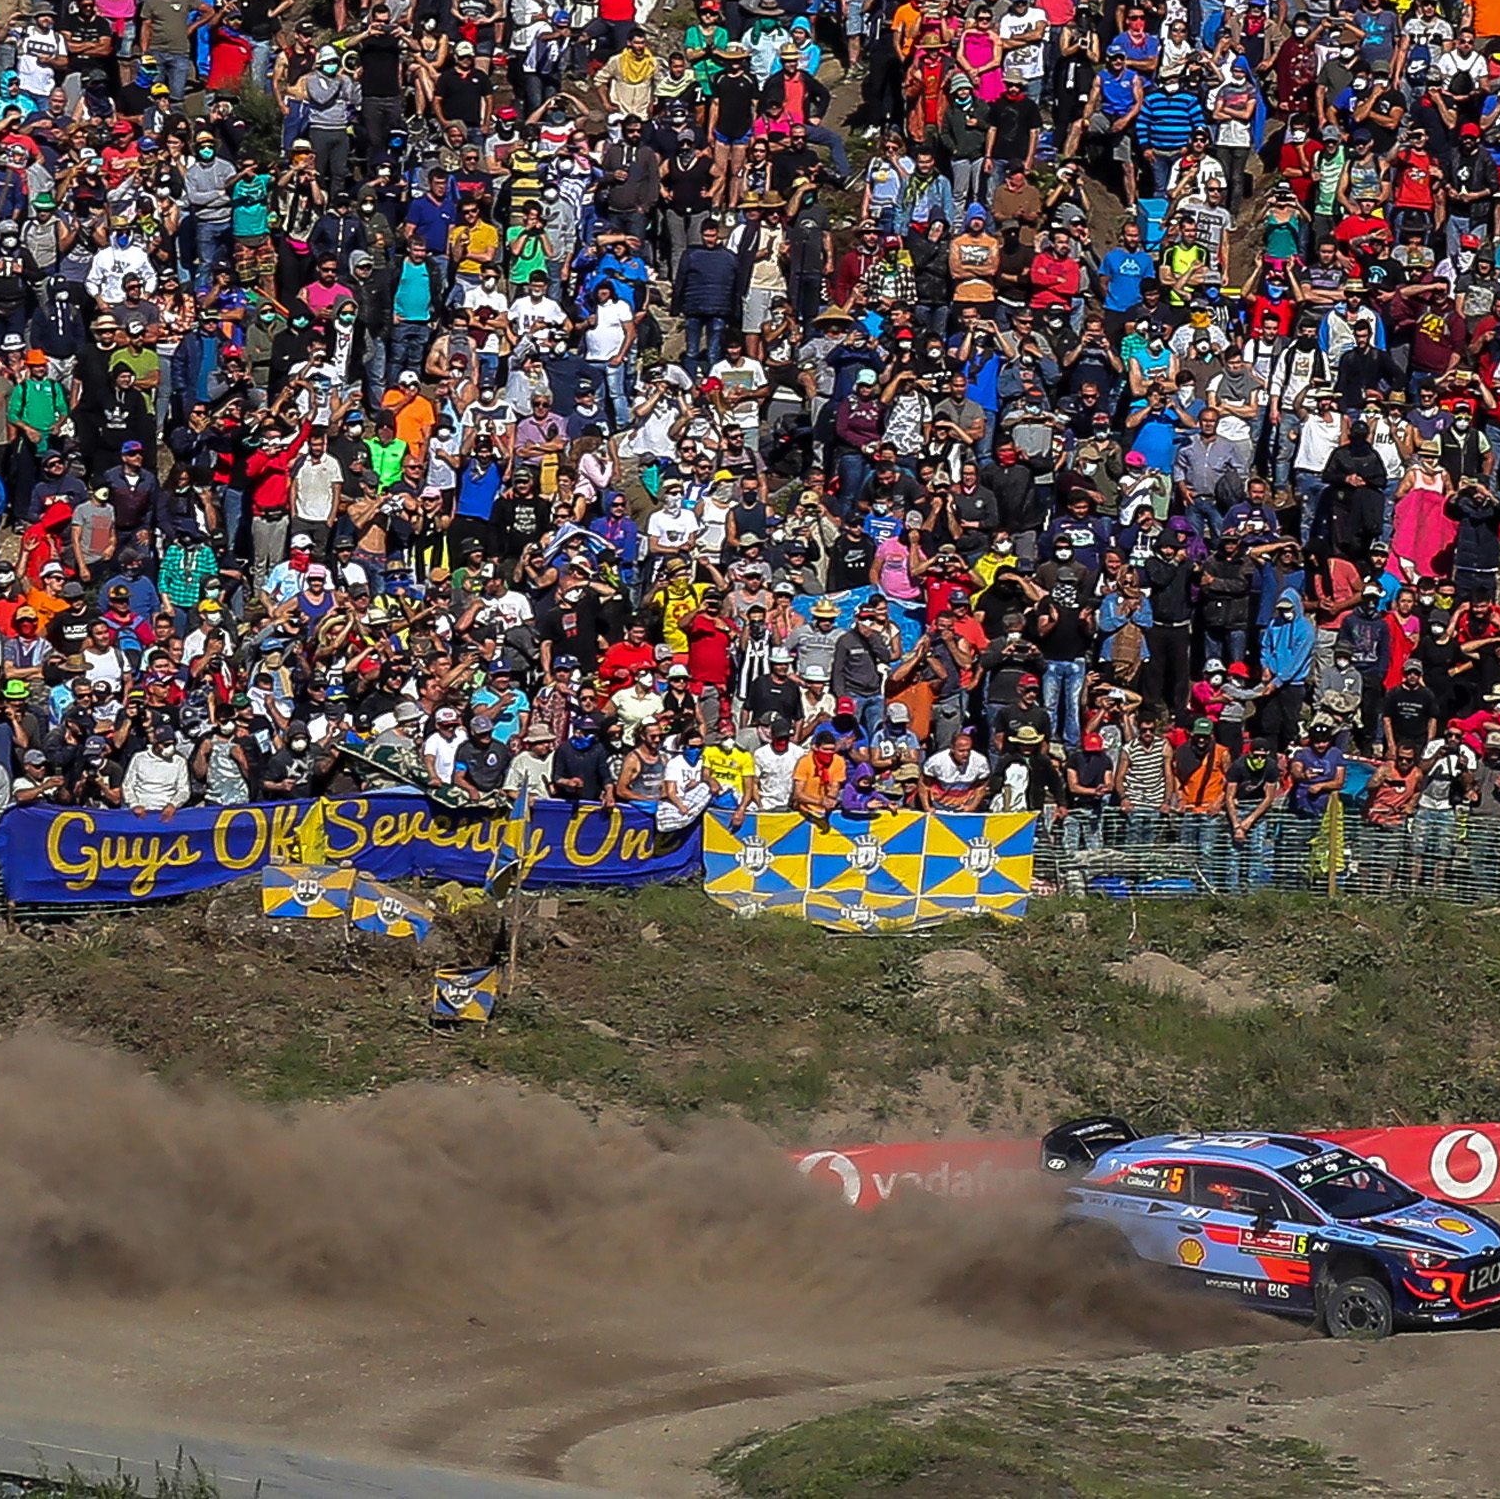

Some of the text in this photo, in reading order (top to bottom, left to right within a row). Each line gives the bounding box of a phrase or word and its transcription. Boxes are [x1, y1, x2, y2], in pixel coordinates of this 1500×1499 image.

[47, 811, 202, 897] Guys
[563, 804, 683, 867] One
[1168, 1167, 1185, 1194] 5
[1296, 1236, 1308, 1254] 5
[1243, 1280, 1290, 1299] MOBIS
